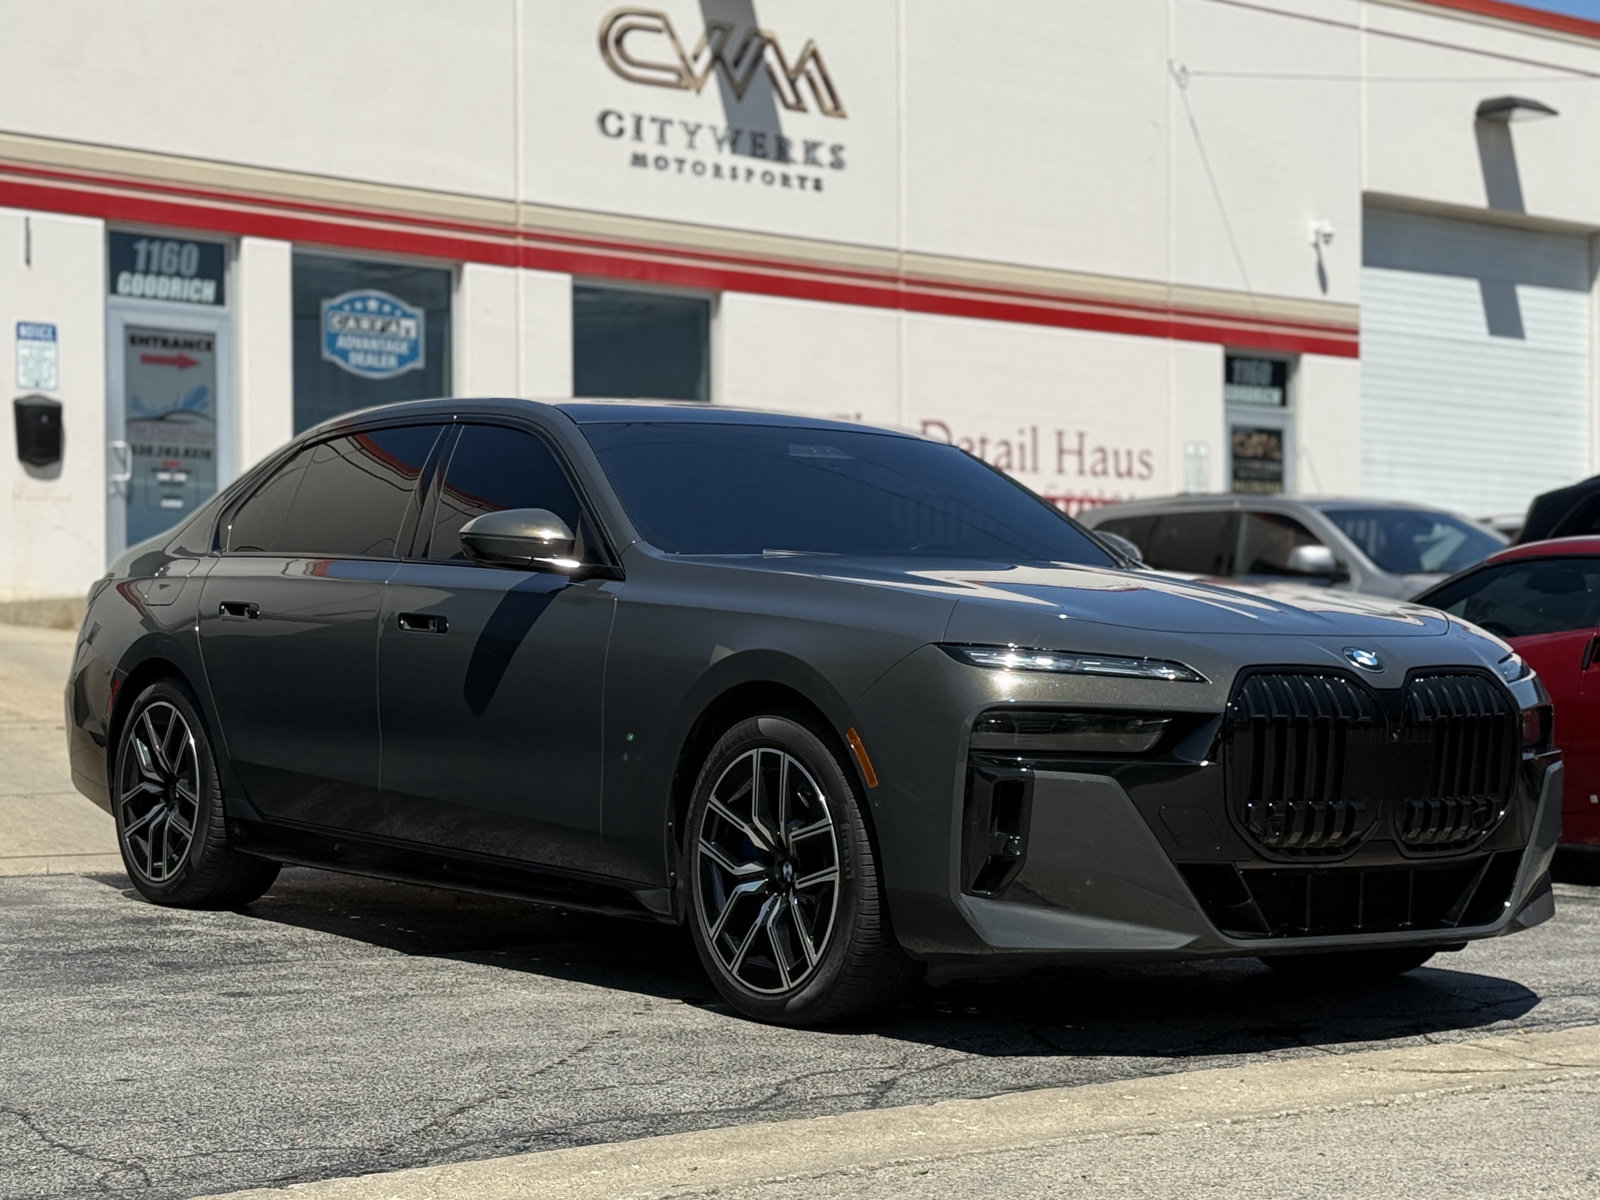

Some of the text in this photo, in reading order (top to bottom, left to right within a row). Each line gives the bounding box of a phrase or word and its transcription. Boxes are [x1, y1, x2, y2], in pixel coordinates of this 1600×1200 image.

[596, 109, 847, 170] CITYWERKS
[630, 151, 824, 193] MOTORSPORTS
[133, 239, 200, 277] 1160
[117, 270, 216, 303] GOODRICH
[129, 334, 213, 351] ENTRANCE
[1055, 428, 1155, 481] Haus
